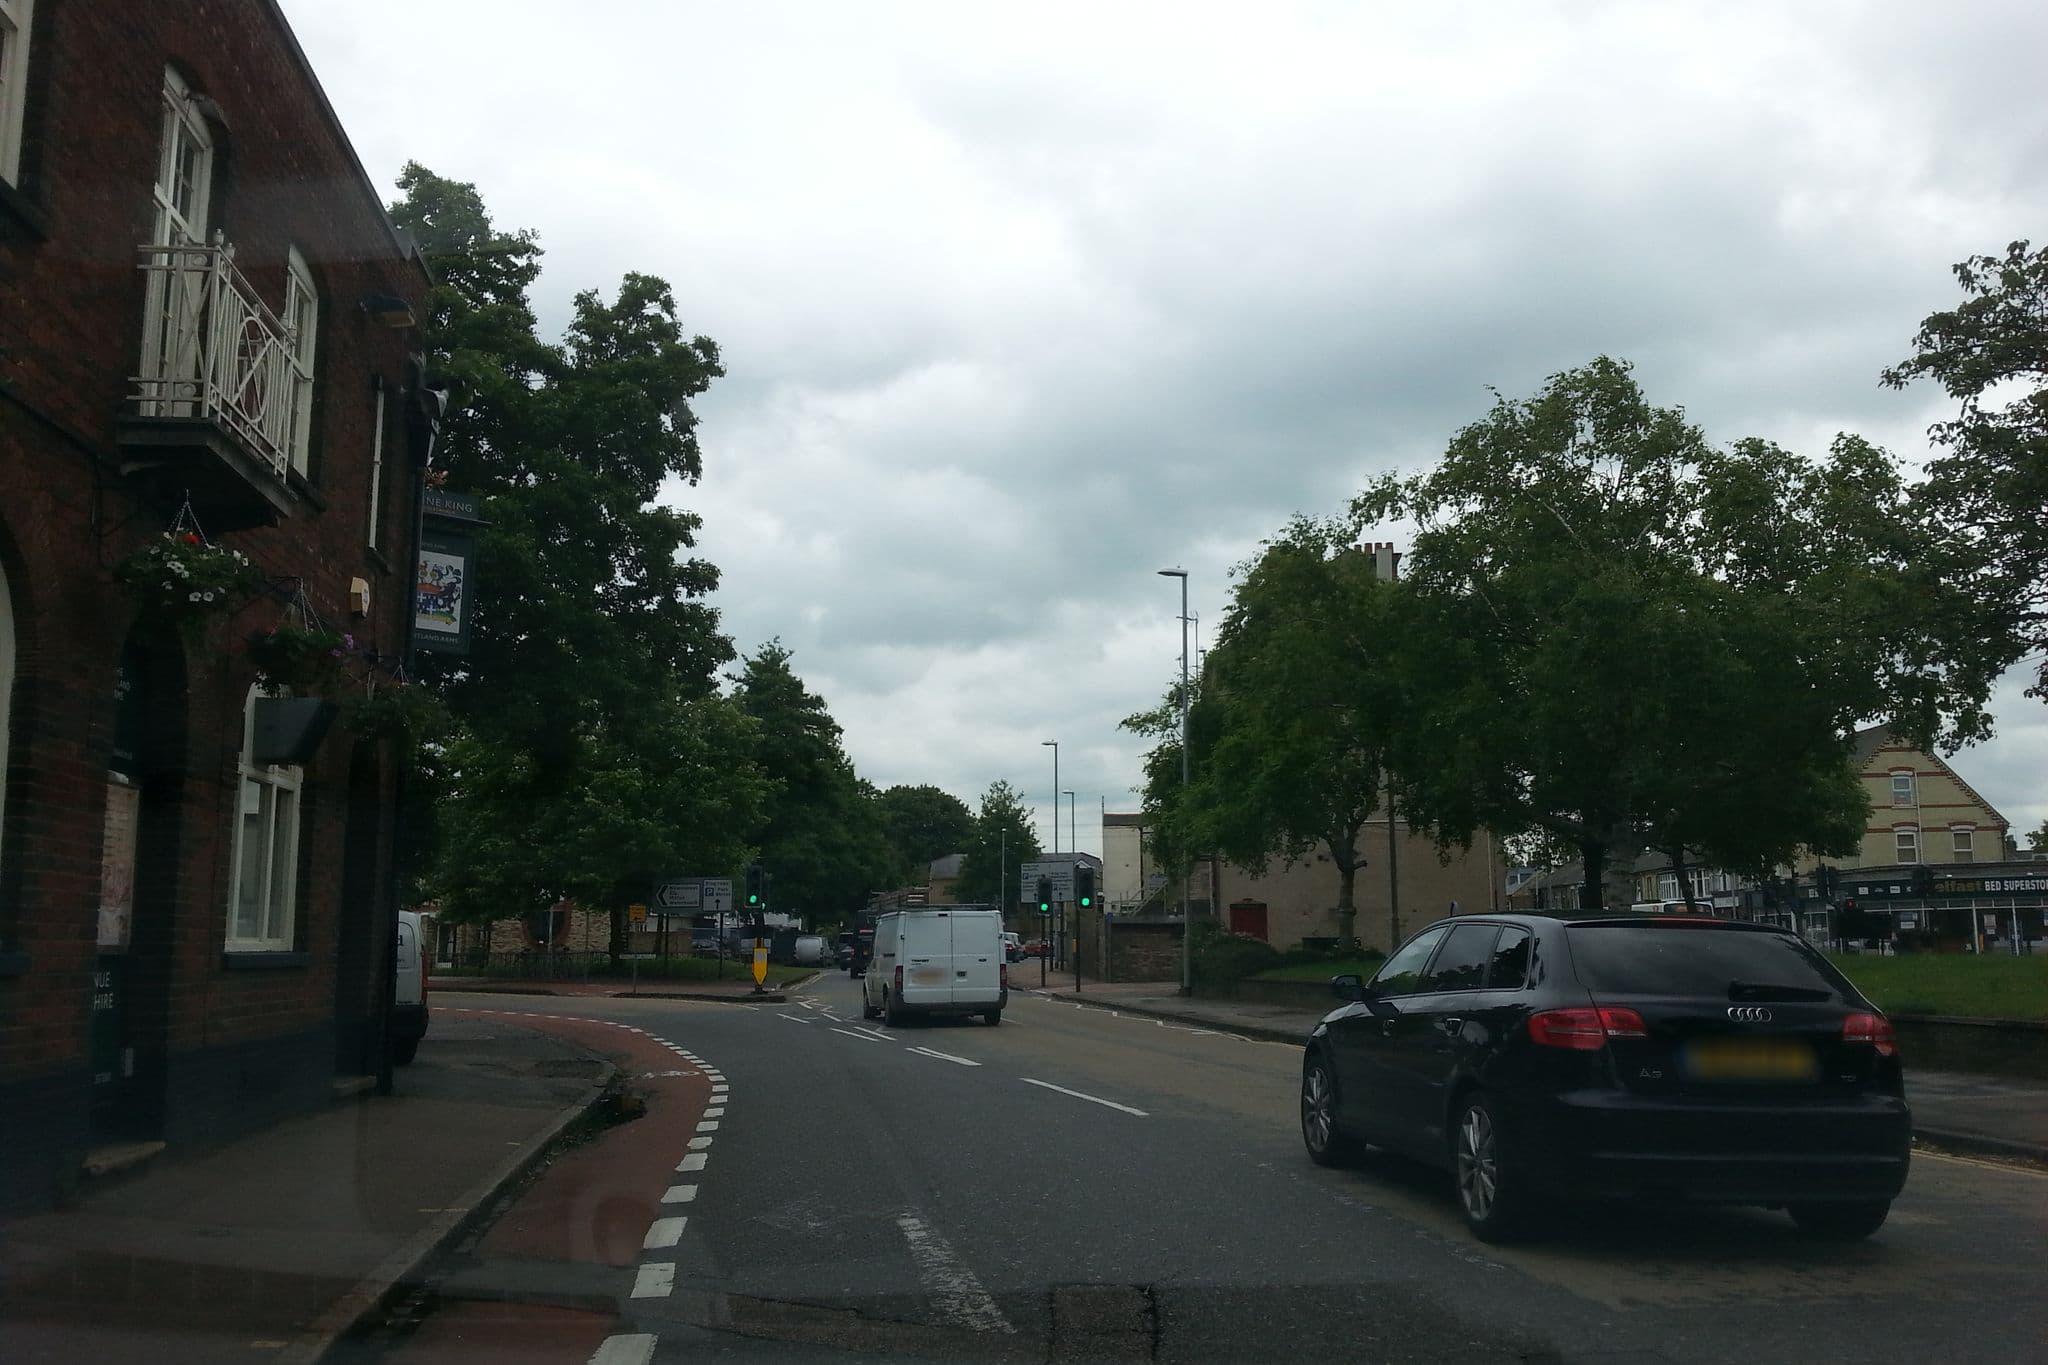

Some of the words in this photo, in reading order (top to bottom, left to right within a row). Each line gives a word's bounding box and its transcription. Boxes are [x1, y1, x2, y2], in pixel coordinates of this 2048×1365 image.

[427, 496, 441, 507] NE
[444, 498, 473, 513] KING
[1935, 881, 1983, 892] elfast
[1984, 880, 2001, 892] BED
[93, 992, 113, 1009] HIRE
